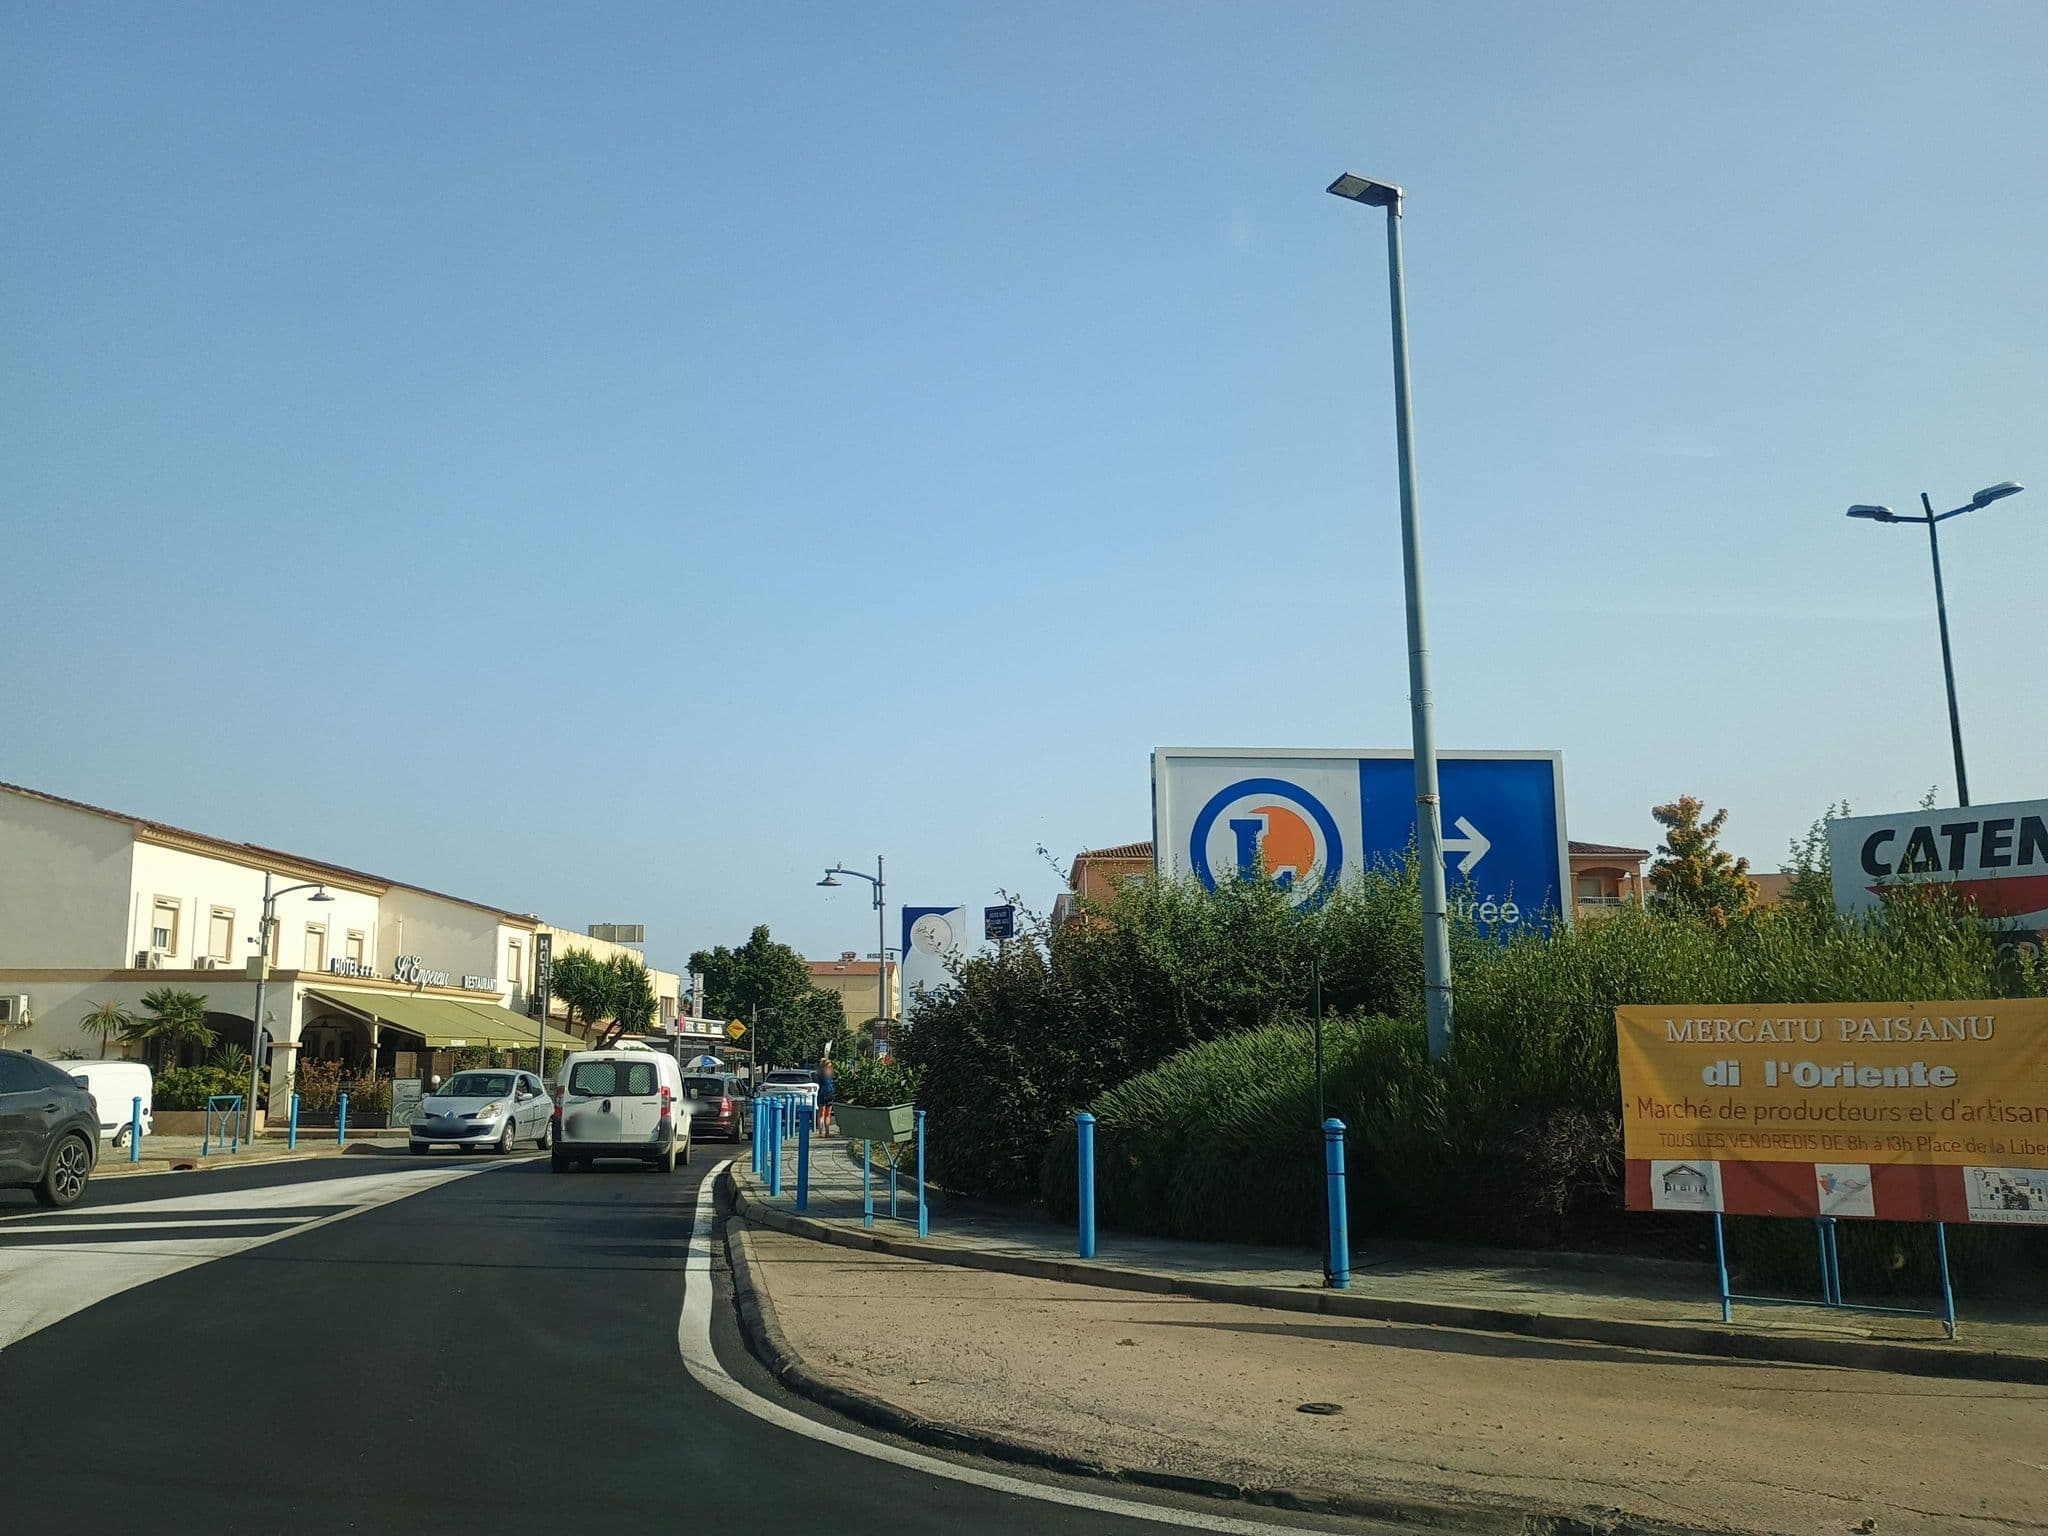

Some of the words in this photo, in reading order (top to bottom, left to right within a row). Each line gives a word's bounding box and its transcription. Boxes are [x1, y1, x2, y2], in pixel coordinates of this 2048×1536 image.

[333, 957, 358, 976] HOTEL
[464, 975, 497, 992] RESTAURANT
[1664, 1018, 1824, 1044] MERCATU
[1837, 1015, 1996, 1043] PAISANU
[1702, 1060, 1741, 1087] di
[1764, 1060, 1958, 1089] l'Oriente
[1637, 1096, 1712, 1120] Marché
[1718, 1098, 1746, 1121] de
[1753, 1098, 1902, 1126] producteurs
[1908, 1100, 1935, 1122] et
[1658, 1132, 1693, 1148] TOUS
[1697, 1133, 1725, 1149] LES
[1728, 1133, 1818, 1150] VENDREDIS
[1822, 1135, 1844, 1151] DE
[1848, 1135, 1869, 1151] 8h
[1873, 1135, 1883, 1151] à
[1887, 1136, 1913, 1152] 13h
[1917, 1136, 1962, 1153] Place
[1966, 1136, 1985, 1153] de
[1990, 1137, 2005, 1154] la
[2009, 1138, 2048, 1155] Libe
